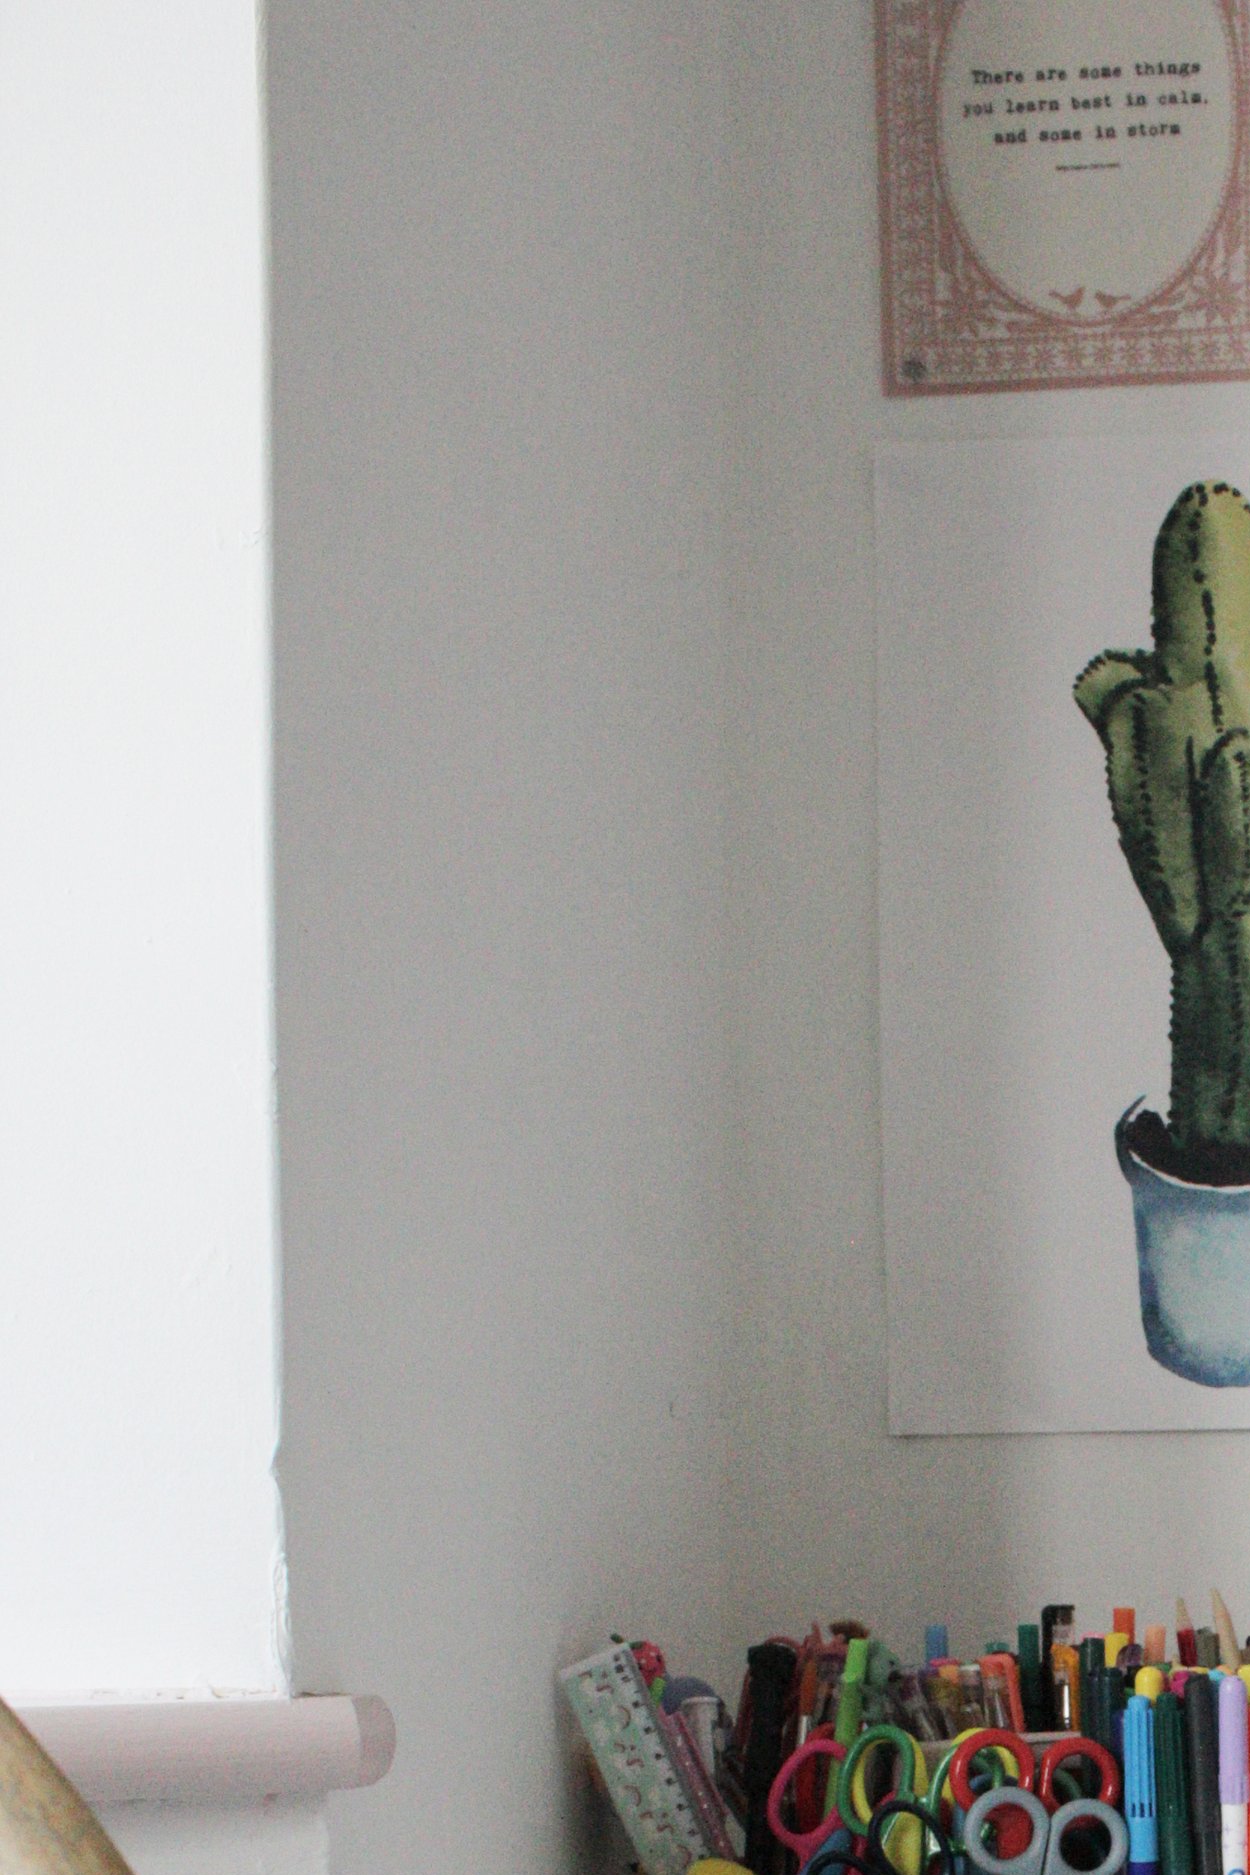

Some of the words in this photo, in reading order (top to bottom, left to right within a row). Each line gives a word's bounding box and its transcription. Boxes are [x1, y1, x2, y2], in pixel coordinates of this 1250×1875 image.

[971, 68, 1025, 85] There
[1036, 66, 1067, 81] are
[1079, 65, 1122, 80] some
[1135, 60, 1201, 77] things
[963, 102, 994, 118] you
[1006, 99, 1060, 114] learn
[1071, 95, 1111, 110] best
[1126, 92, 1147, 107] in
[994, 128, 1028, 144] and
[1039, 129, 1082, 142] some
[1095, 125, 1117, 139] in
[1127, 123, 1181, 138] storm
